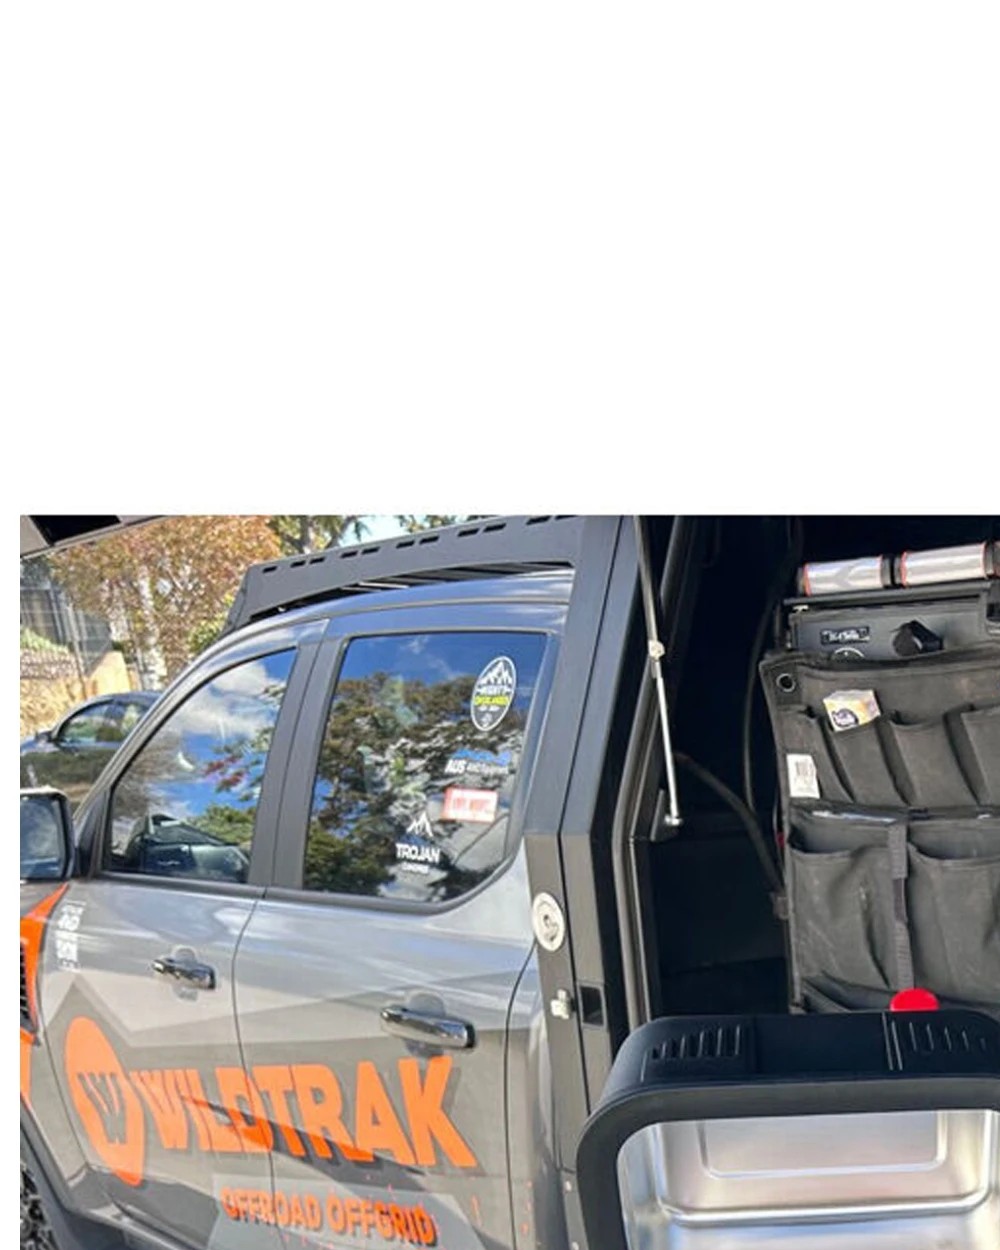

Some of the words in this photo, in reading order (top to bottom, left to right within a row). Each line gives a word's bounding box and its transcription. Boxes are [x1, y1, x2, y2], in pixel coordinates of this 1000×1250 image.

[395, 842, 440, 864] TROJAN
[129, 1056, 478, 1168] WILDTRAK
[220, 1187, 323, 1231] OFFROAD
[325, 1193, 440, 1247] OFFGRID
